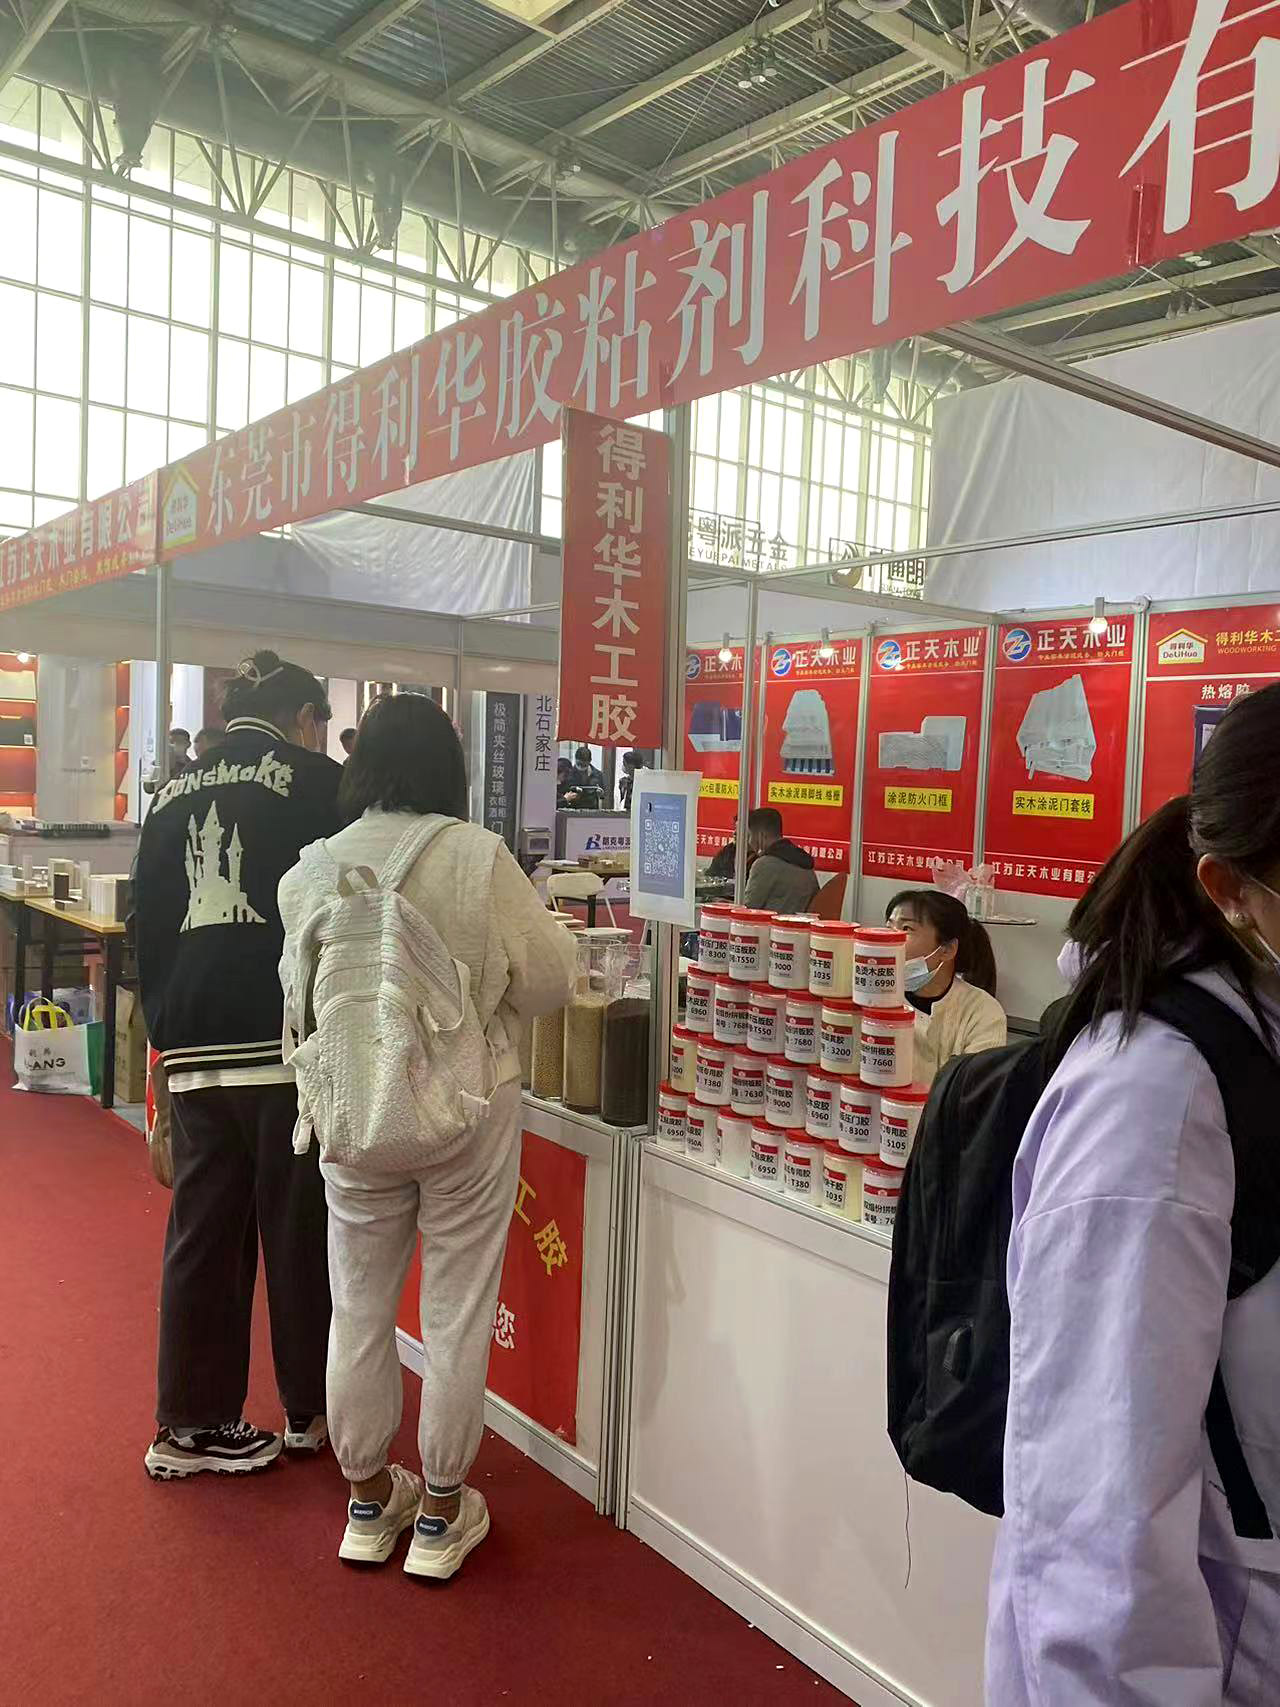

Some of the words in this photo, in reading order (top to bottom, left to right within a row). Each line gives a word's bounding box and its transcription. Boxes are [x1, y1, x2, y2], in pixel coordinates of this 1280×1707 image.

[588, 422, 648, 743] 得利华木工胶
[1037, 624, 1126, 652] 正天木业
[794, 648, 857, 668] 正天木业
[906, 637, 980, 662] 正天木业
[1217, 645, 1277, 655] WOODWORKING
[535, 696, 552, 772] 北石家庄
[887, 791, 949, 807] 涂泥防火门框
[1014, 797, 1092, 814] 实木涂泥门套线
